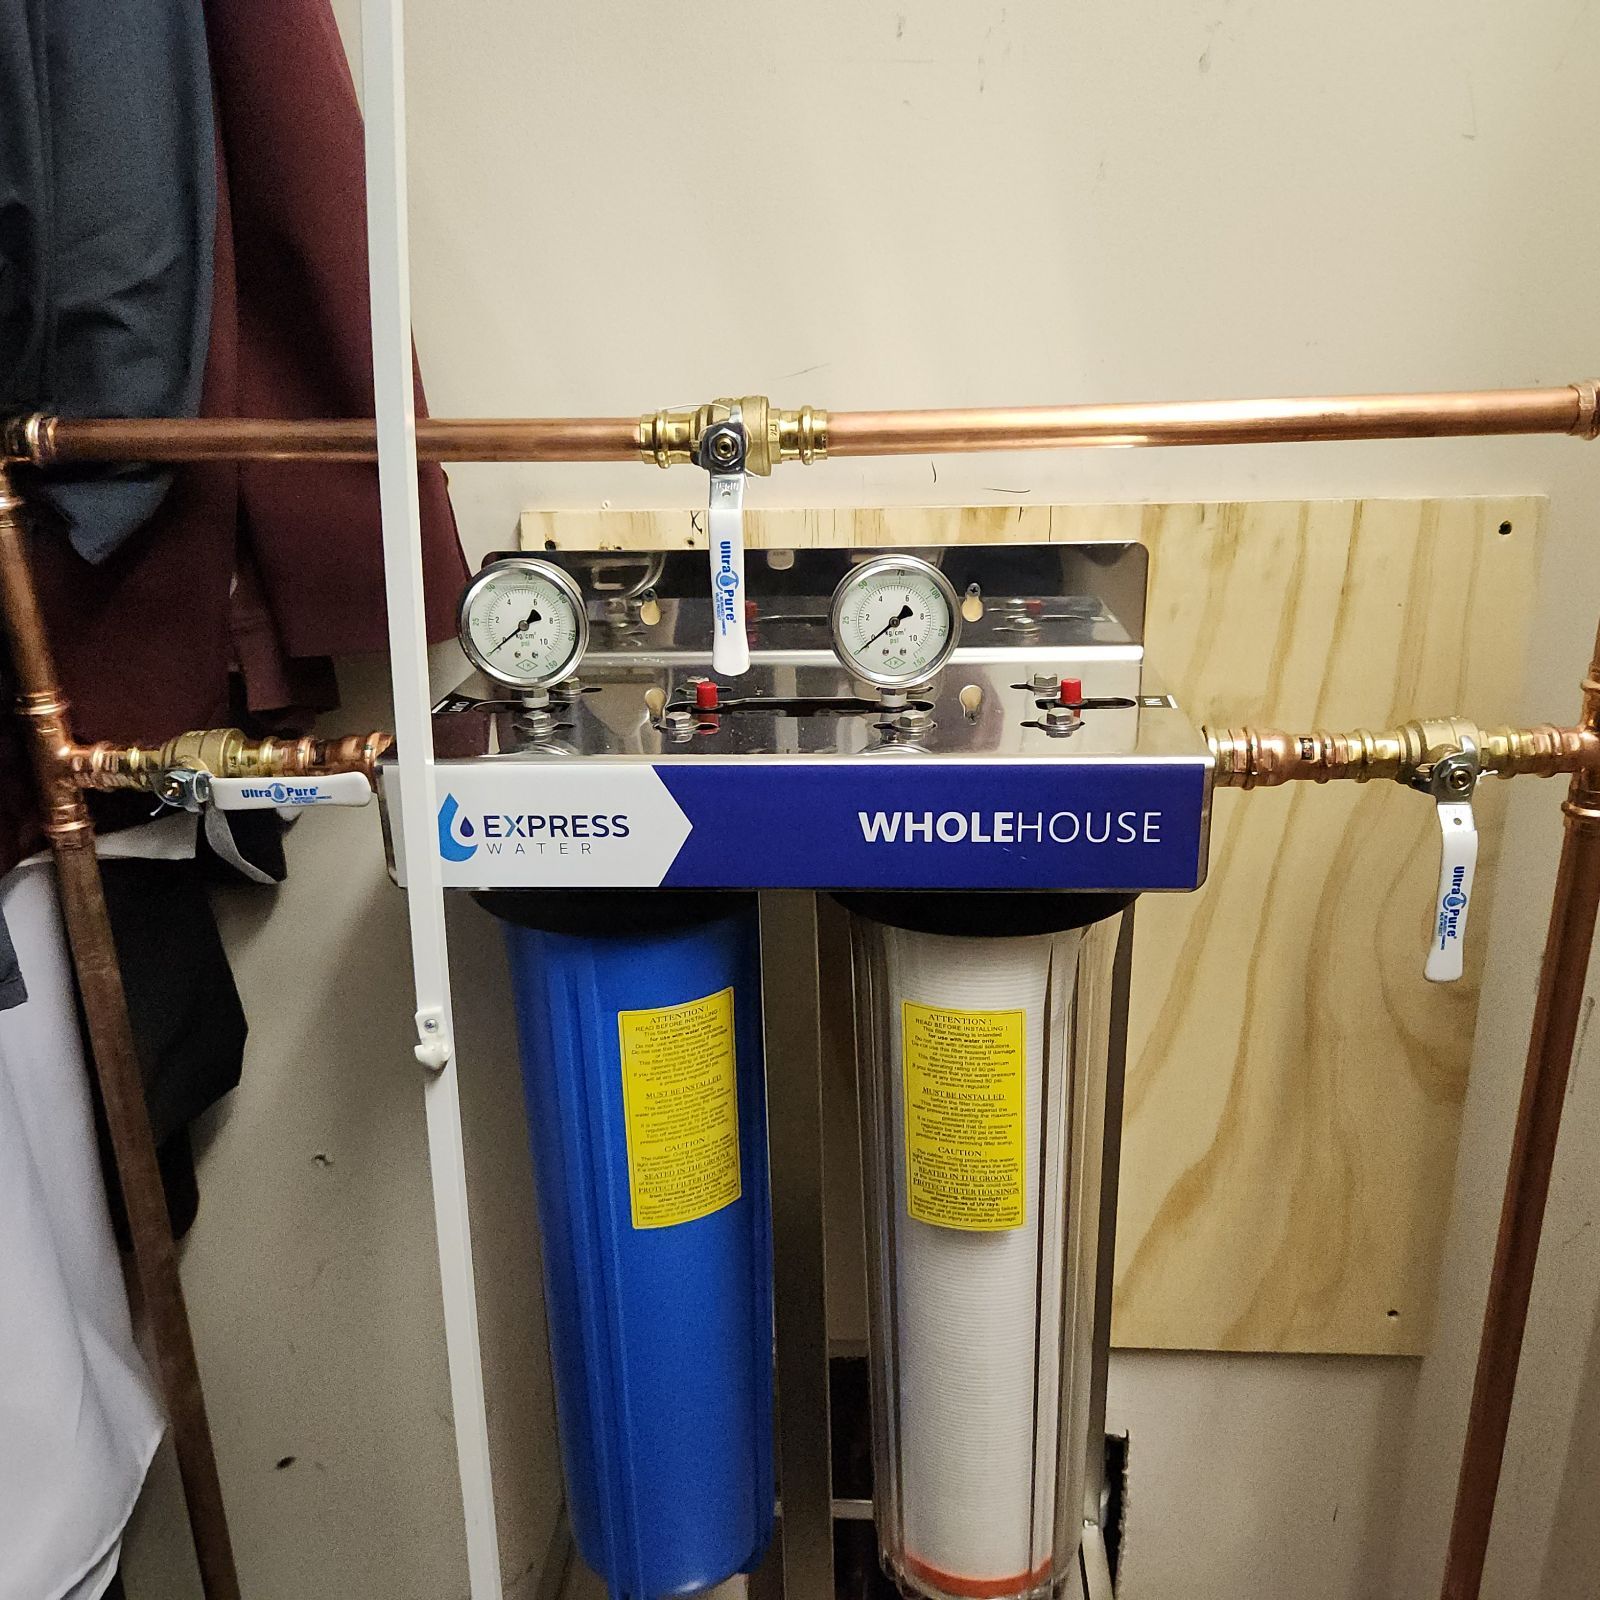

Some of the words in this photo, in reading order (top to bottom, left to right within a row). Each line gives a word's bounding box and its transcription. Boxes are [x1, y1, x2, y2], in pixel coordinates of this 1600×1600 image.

[720, 540, 730, 573] Ultra
[486, 584, 495, 592] 50
[858, 581, 867, 589] 50
[930, 588, 940, 599] 100
[843, 616, 849, 624] 25
[546, 660, 558, 670] 150
[913, 657, 925, 667] 150
[241, 789, 271, 798] Ultra
[484, 815, 630, 838] EXPRESS
[858, 811, 1161, 843] WHOLEHOUSE
[486, 842, 591, 855] WATER
[1452, 866, 1464, 894] Ultra
[916, 1018, 933, 1027] READ
[935, 1023, 960, 1031] BEFORE
[929, 1014, 986, 1025] ATTENTION
[927, 1067, 947, 1075] suspect
[928, 1062, 953, 1070] operating
[922, 1087, 945, 1097] MUST
[927, 1108, 949, 1116] pressure
[938, 1147, 981, 1156] CAUTION
[919, 1166, 947, 1178] SEATED
[913, 1178, 947, 1192] PROTECT
[949, 1187, 976, 1195] FILTER
[978, 1187, 1019, 1195] HOUSINGS
